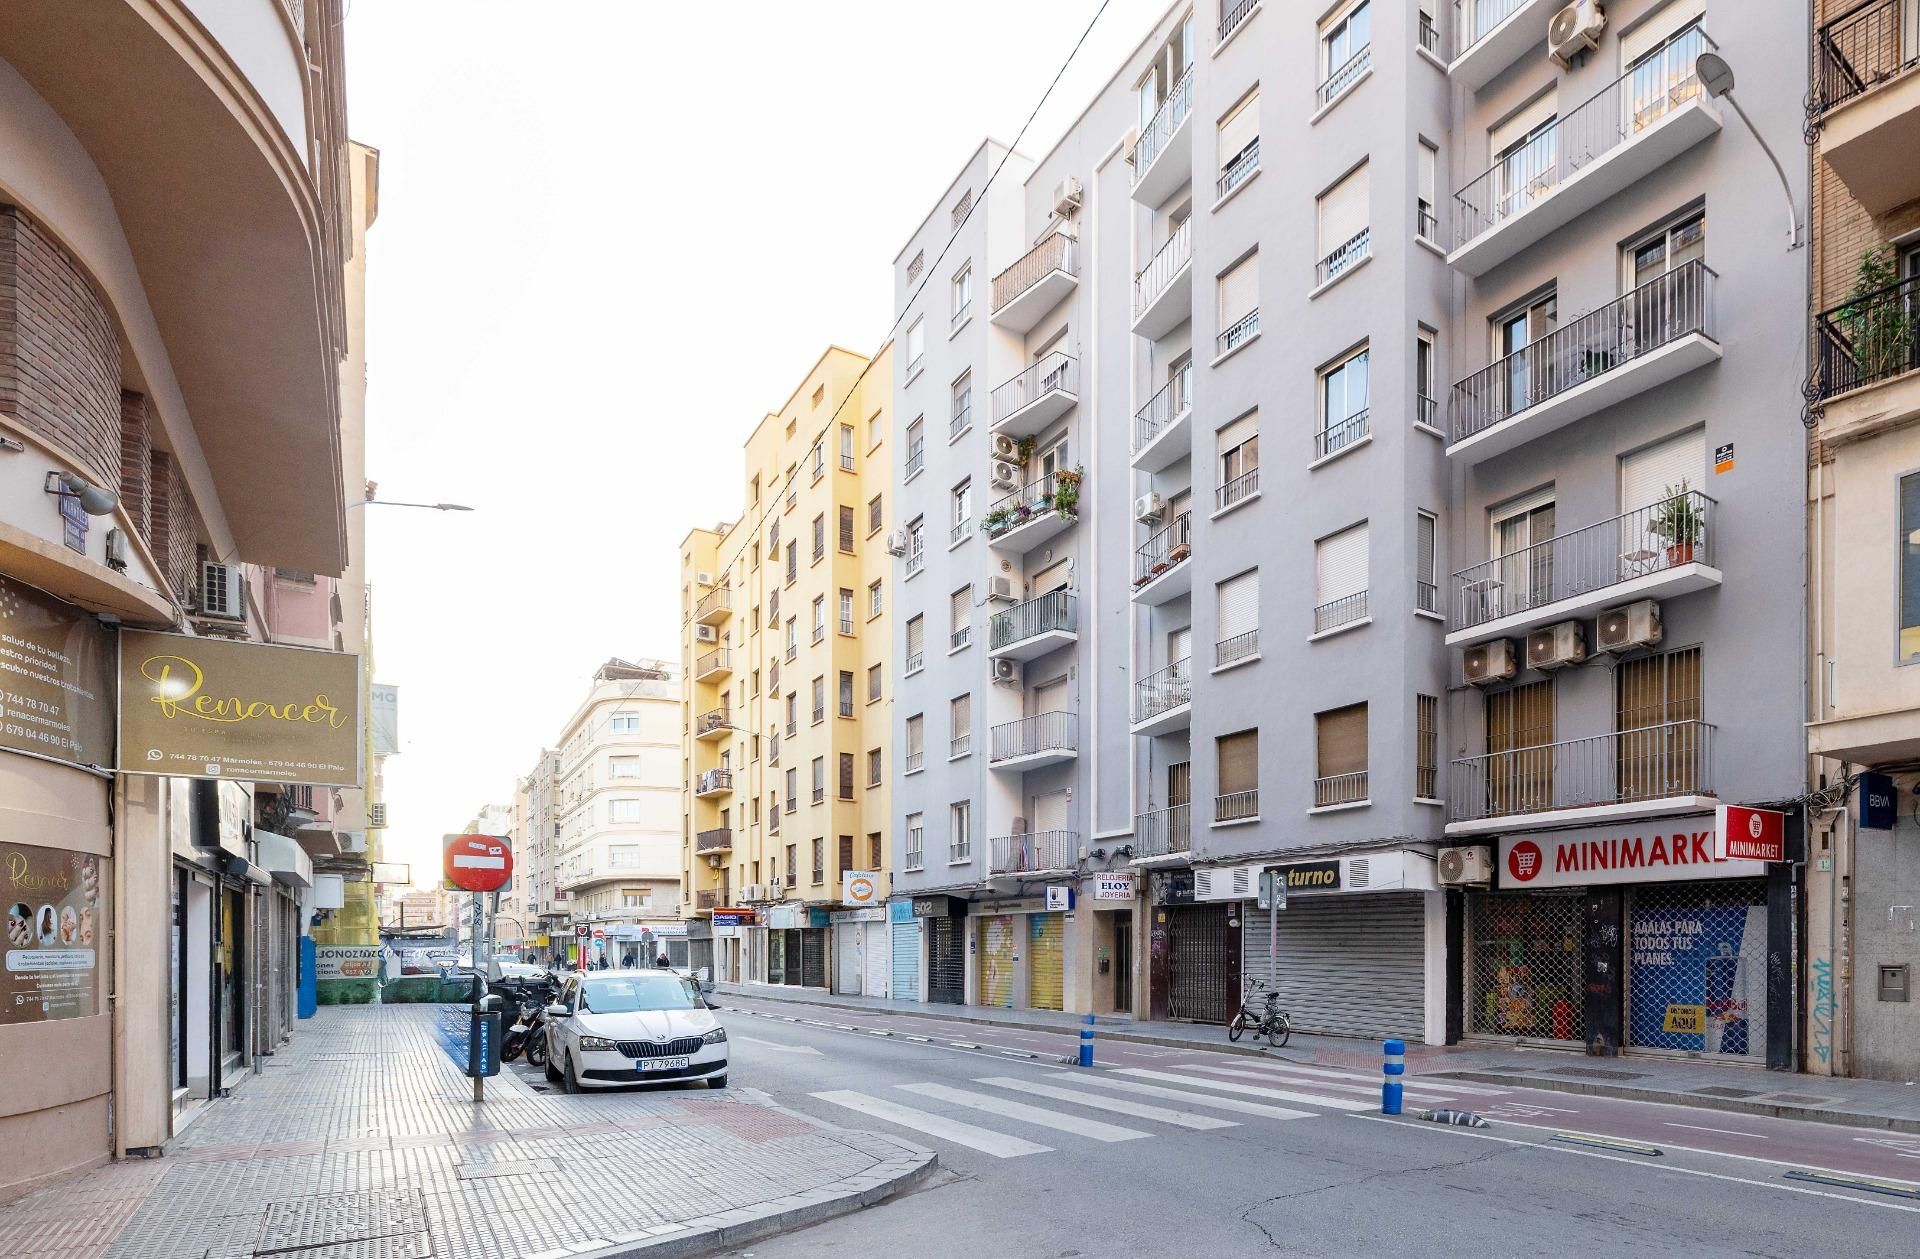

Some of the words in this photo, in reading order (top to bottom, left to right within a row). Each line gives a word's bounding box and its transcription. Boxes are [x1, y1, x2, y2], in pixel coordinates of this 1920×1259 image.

[2, 634, 25, 647] salud
[26, 640, 36, 650] de
[38, 644, 46, 654] tu
[0, 648, 23, 660] estra
[25, 656, 58, 672] prioridad.
[30, 672, 60, 686] nuestros
[140, 655, 350, 729] Renacer
[7, 692, 23, 706] 744
[26, 698, 36, 709] 78
[39, 702, 49, 712] 70
[50, 706, 60, 716] 47
[8, 708, 71, 732] renacermarmoles
[6, 724, 23, 736] 679
[26, 729, 36, 740] 04
[39, 732, 49, 742] 46
[50, 735, 60, 746] 90
[62, 738, 69, 748] El
[1870, 794, 1890, 807] BBVA
[1556, 831, 1728, 872] MINIMARK
[1730, 841, 1779, 858] MINIMARKET
[1269, 868, 1334, 886] turno
[914, 902, 932, 914] 502
[1675, 921, 1702, 934] PARA
[1635, 937, 1670, 950] TODOS
[1672, 937, 1692, 950] TUS
